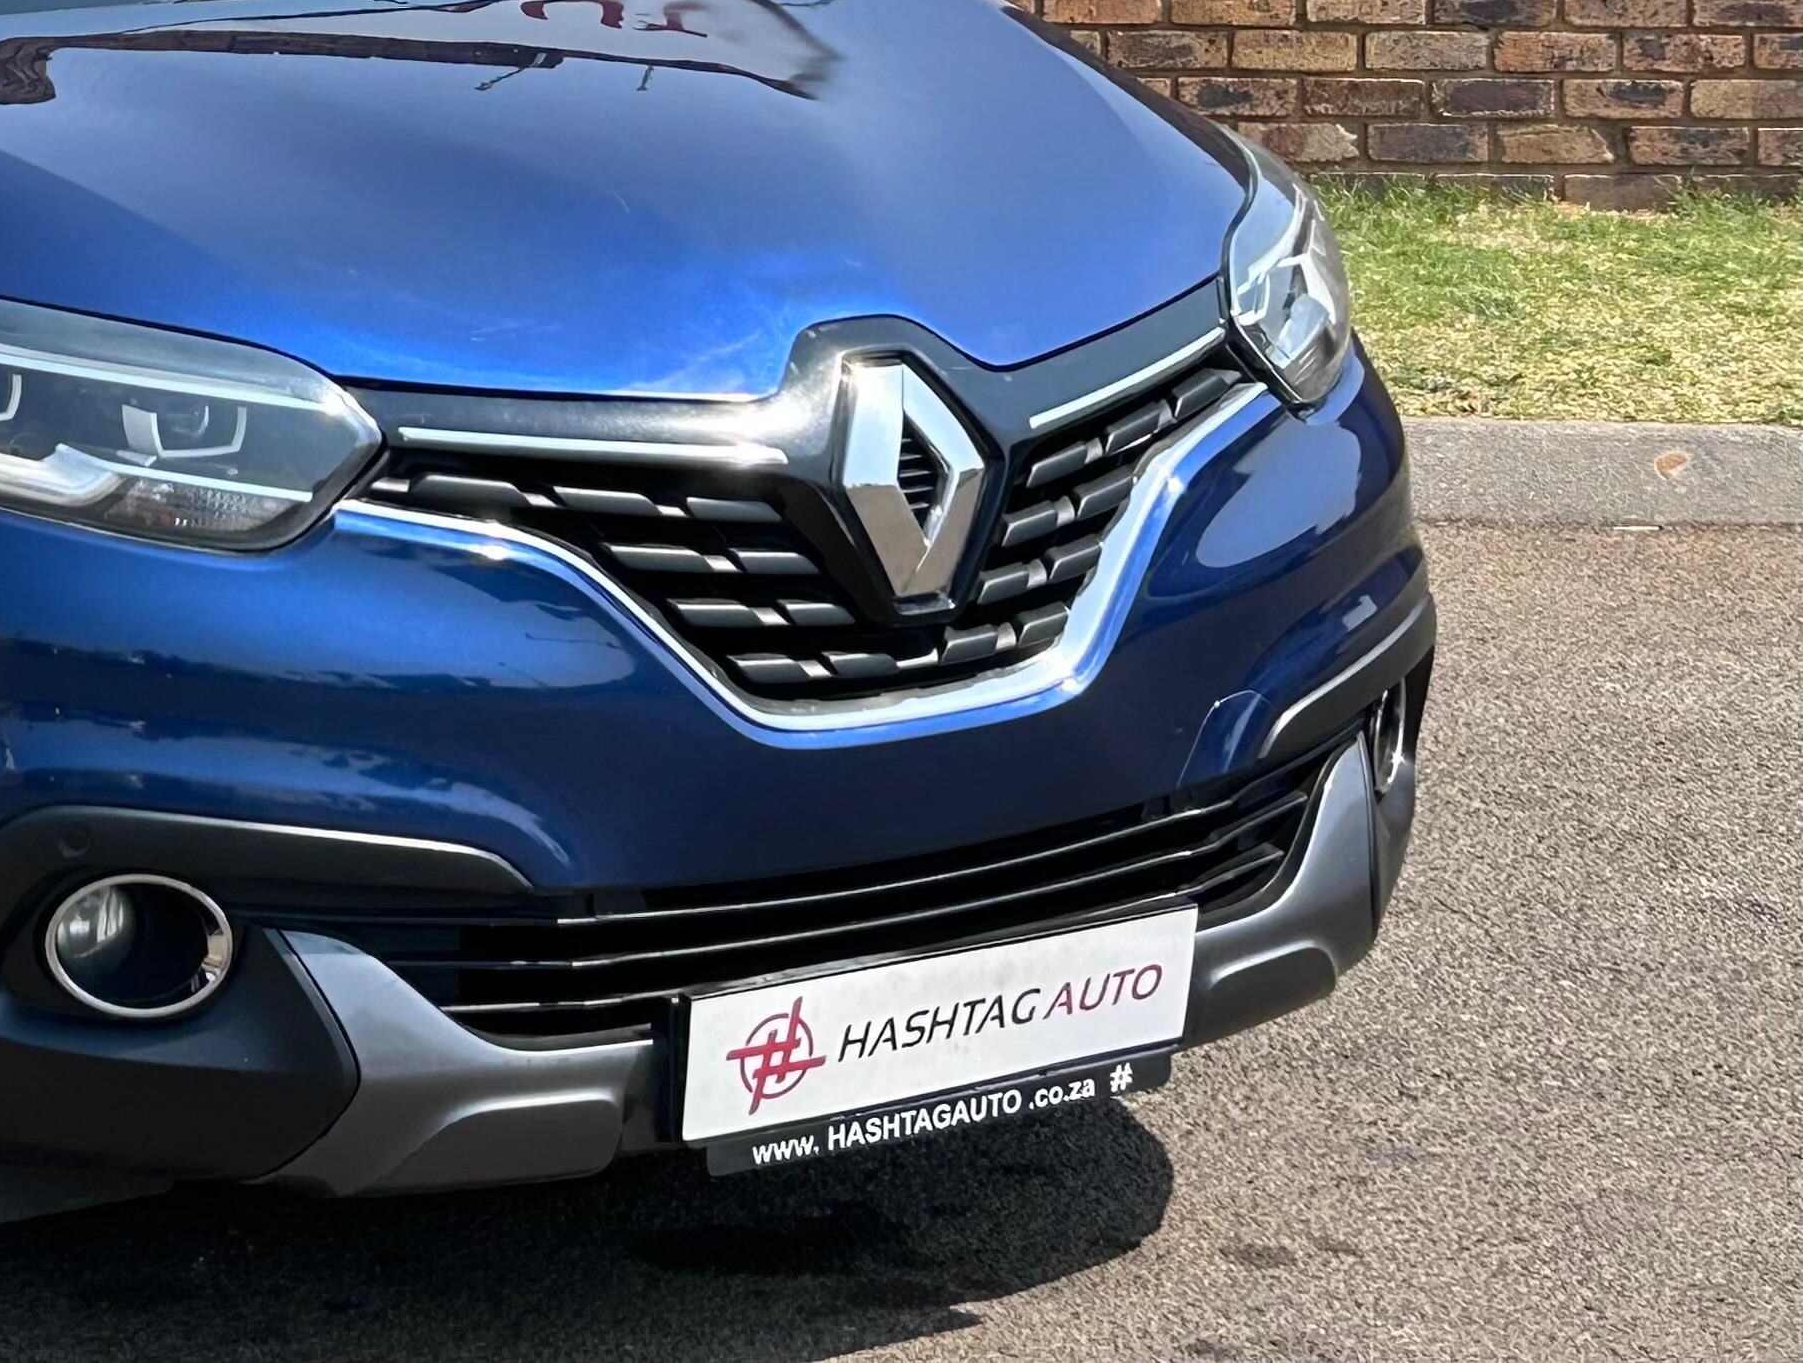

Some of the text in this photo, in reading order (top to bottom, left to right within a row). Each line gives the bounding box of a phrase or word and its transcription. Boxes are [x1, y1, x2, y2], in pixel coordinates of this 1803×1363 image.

[837, 964, 1163, 1062] HASHTAG AUTO
[827, 1087, 1022, 1151] HASHTAGAUTO
[1029, 1078, 1096, 1110] .co.za
